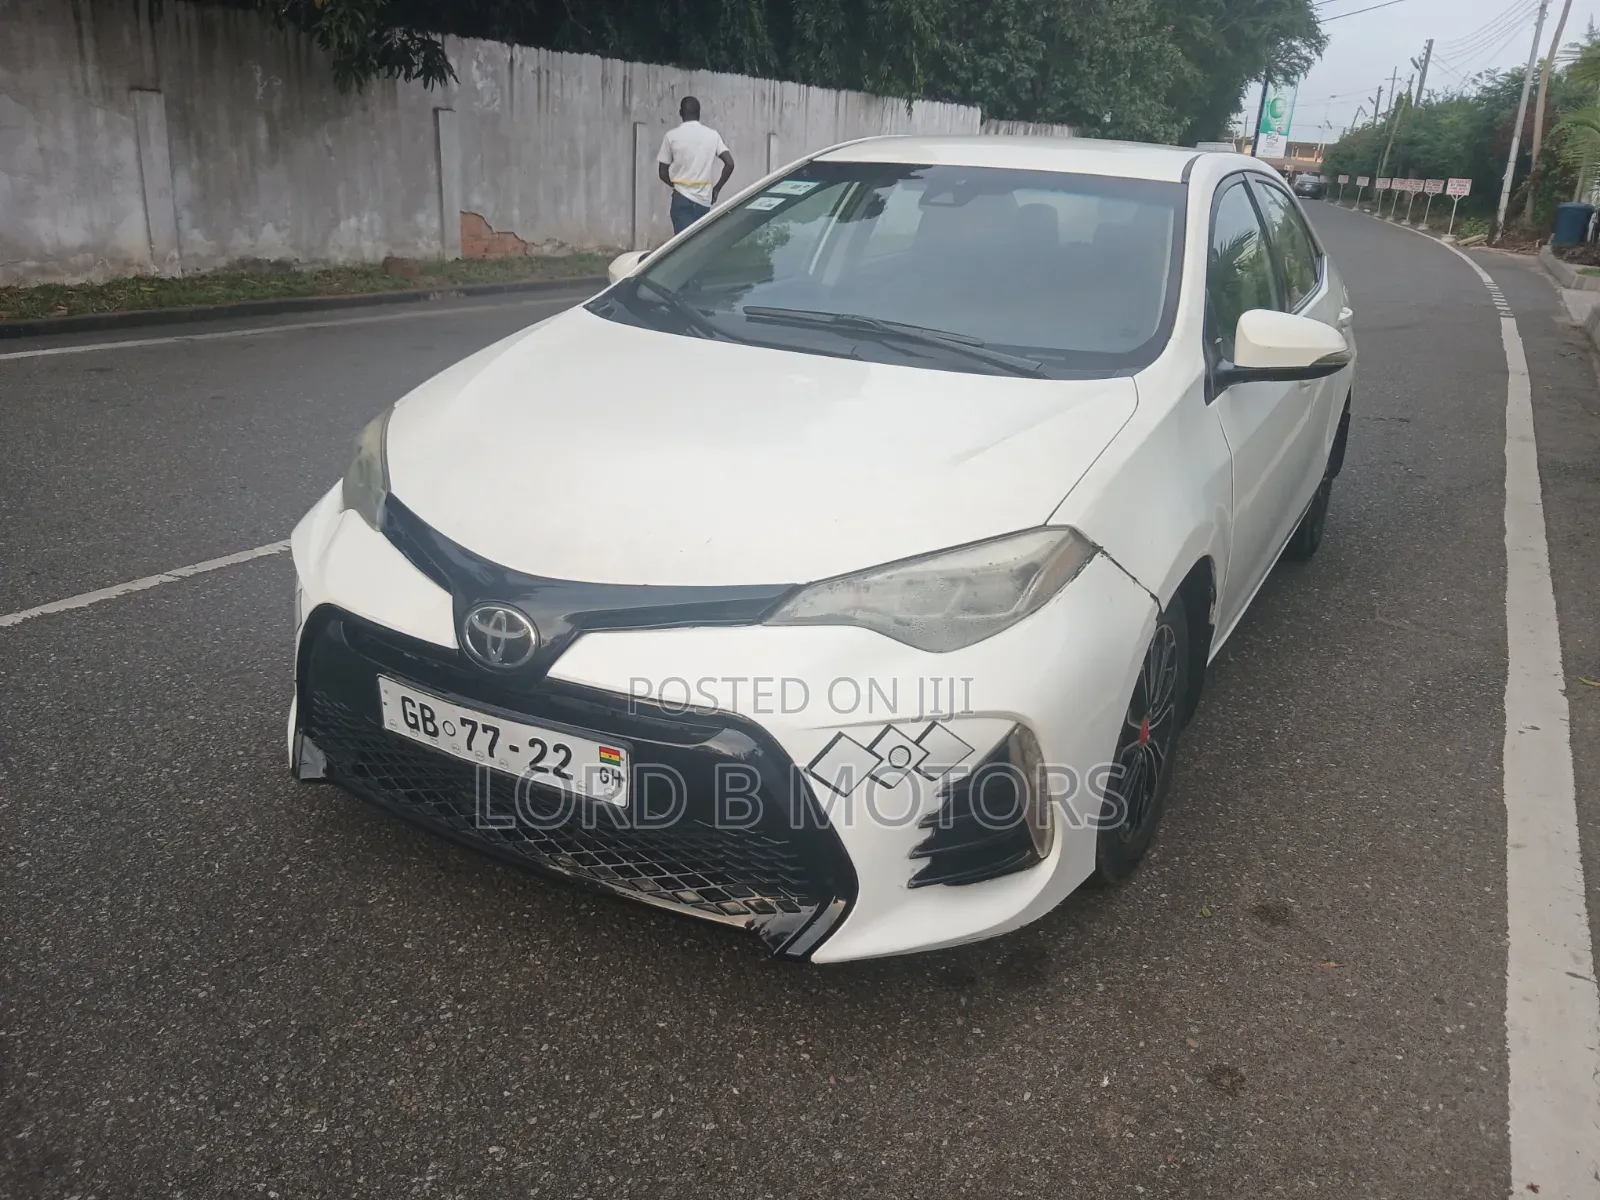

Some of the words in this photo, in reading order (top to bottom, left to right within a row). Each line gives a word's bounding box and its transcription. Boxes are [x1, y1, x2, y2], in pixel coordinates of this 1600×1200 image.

[400, 695, 440, 738] GB
[459, 716, 574, 781] 77-22
[599, 766, 622, 788] GH
